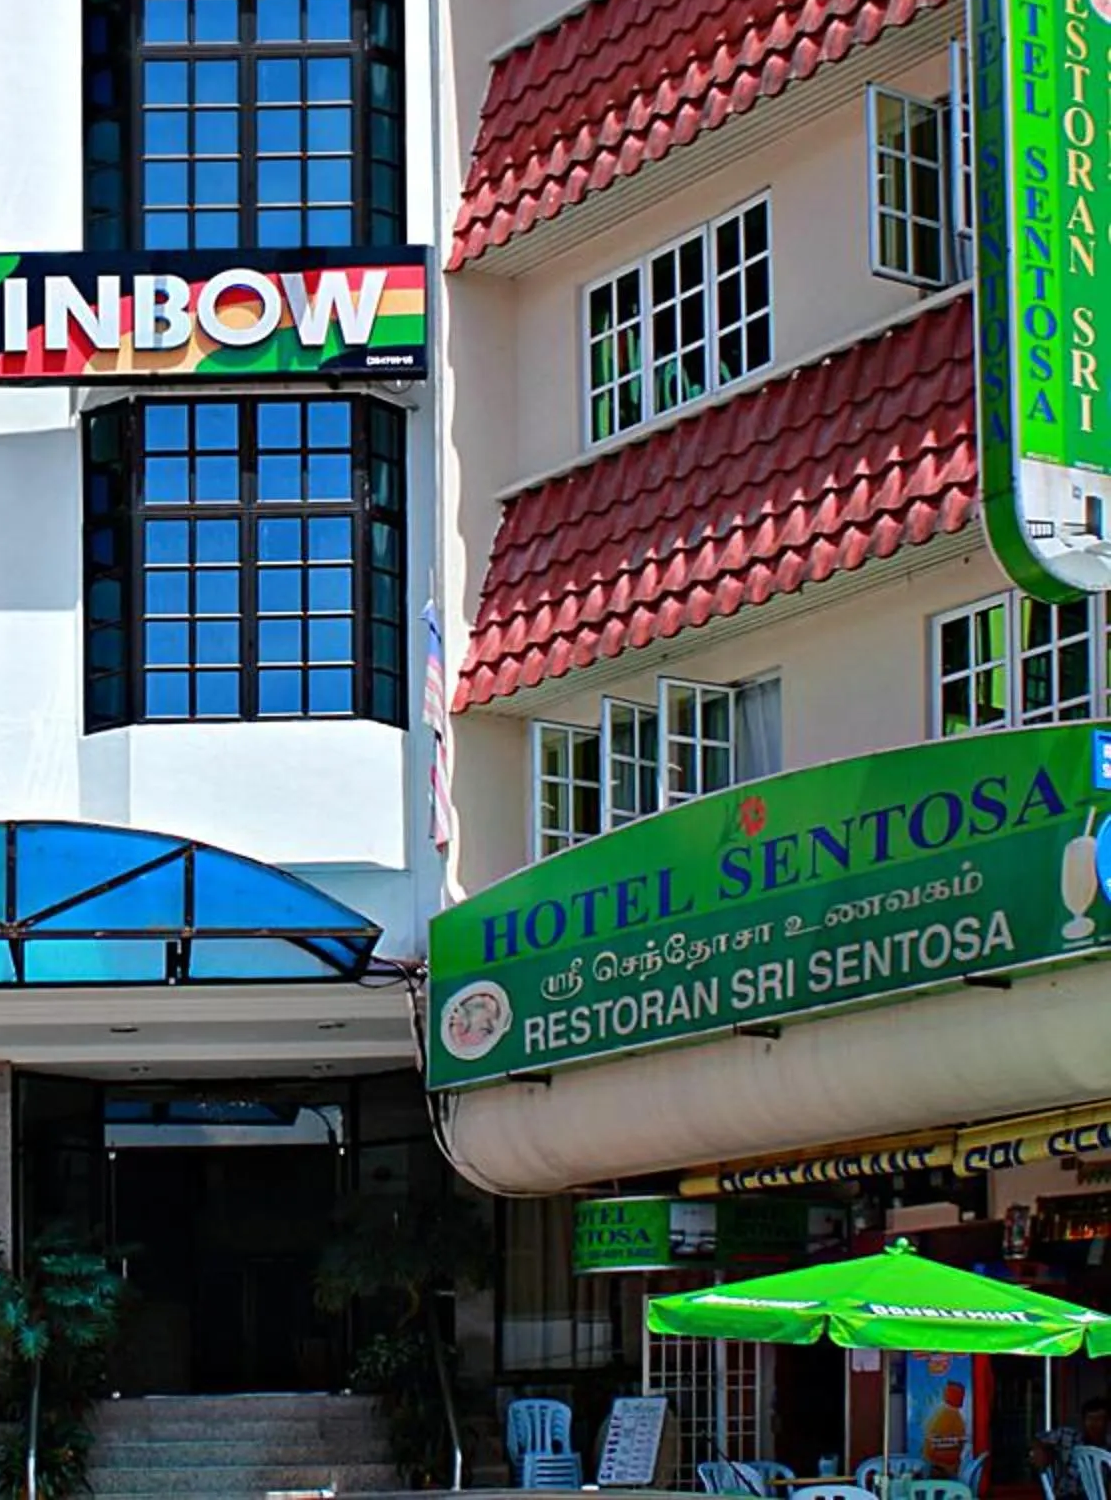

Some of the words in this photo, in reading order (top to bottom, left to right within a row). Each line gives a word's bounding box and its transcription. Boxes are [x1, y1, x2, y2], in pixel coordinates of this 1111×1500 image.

[1024, 145, 1058, 424] SENTOSA
[1071, 306, 1099, 433] SRI
[482, 867, 695, 964] HOTEL
[718, 764, 1068, 901] SENTOSA
[783, 860, 984, 938] உணவகம்
[523, 976, 719, 1055] RESTORAN
[730, 958, 795, 1010] SRI
[807, 909, 1016, 994] SENTOSA
[869, 1301, 1031, 1324] DOUBLEMINT
